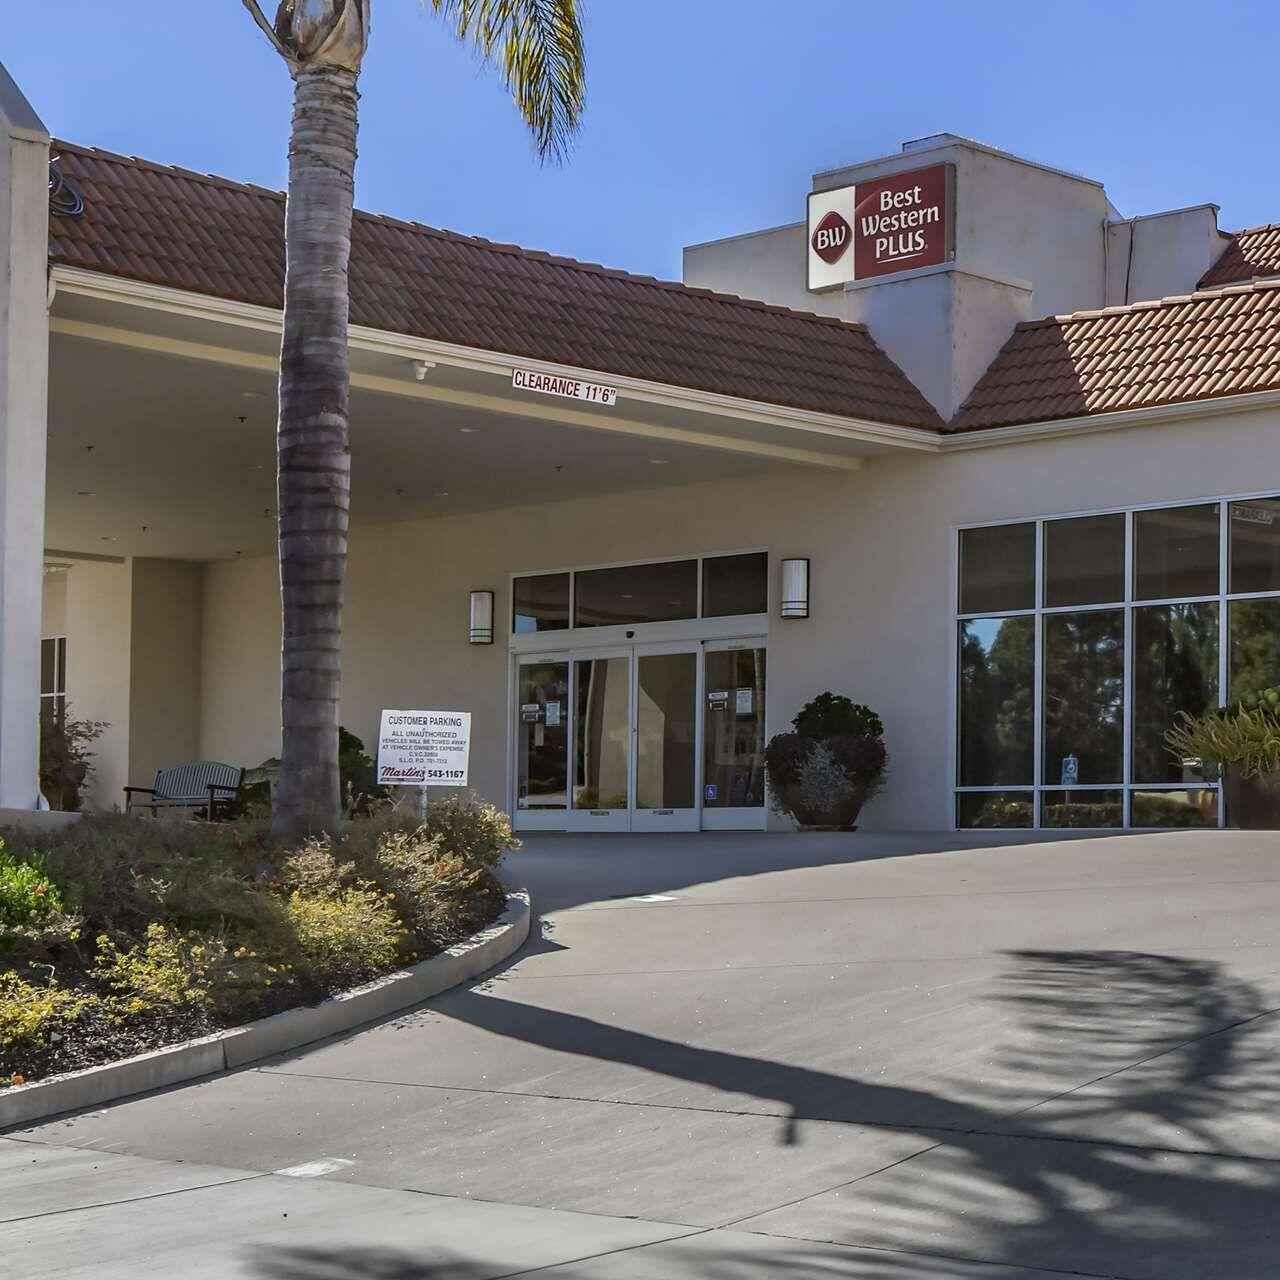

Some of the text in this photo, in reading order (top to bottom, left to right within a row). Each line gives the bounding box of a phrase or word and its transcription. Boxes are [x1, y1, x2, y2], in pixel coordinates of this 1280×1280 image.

[880, 185, 922, 211] Best
[861, 206, 939, 237] Western
[817, 226, 846, 250] BW
[875, 229, 925, 259] PLUS
[514, 371, 581, 397] CLEARANCE
[388, 716, 462, 727] CUSTOMER PARKING
[428, 770, 464, 778] 543-1167
